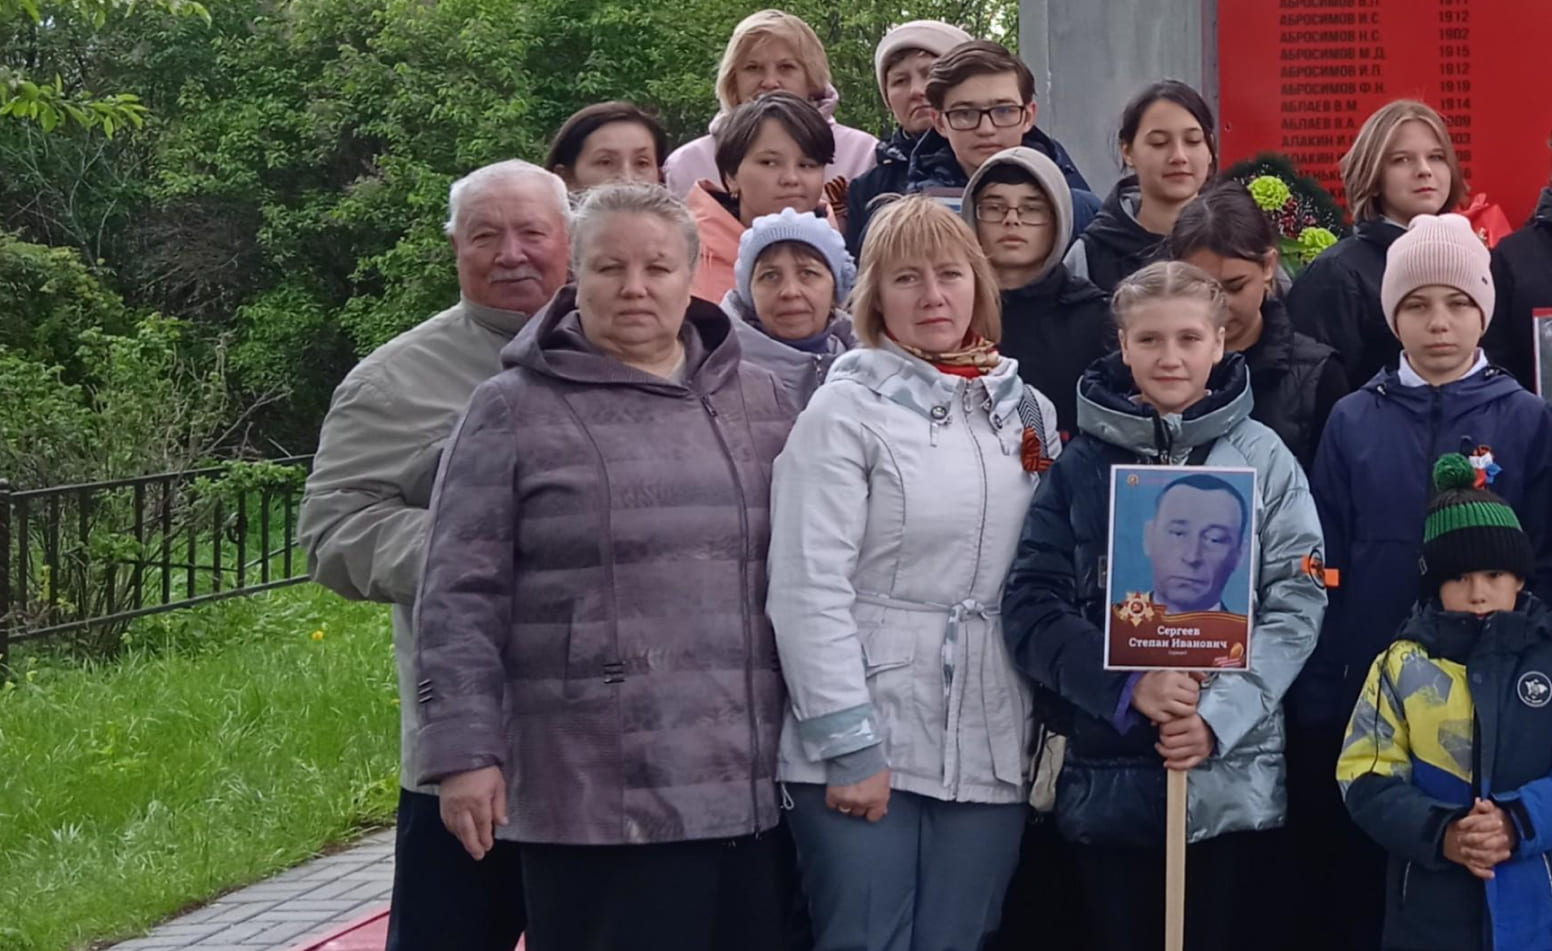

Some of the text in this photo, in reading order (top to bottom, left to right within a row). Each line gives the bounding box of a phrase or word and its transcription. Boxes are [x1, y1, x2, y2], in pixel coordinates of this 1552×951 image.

[1280, 13, 1355, 26] АБРОСИМОВ
[1280, 31, 1355, 43] АБРОСИМОВ
[1280, 48, 1355, 60] АБРОСИМОВ
[1280, 65, 1356, 78] АБРОСИМОВ
[1281, 83, 1356, 95] АБРОСИМОВ
[1157, 625, 1200, 638] Сергеев
[1128, 637, 1228, 650] Степан Иванович
